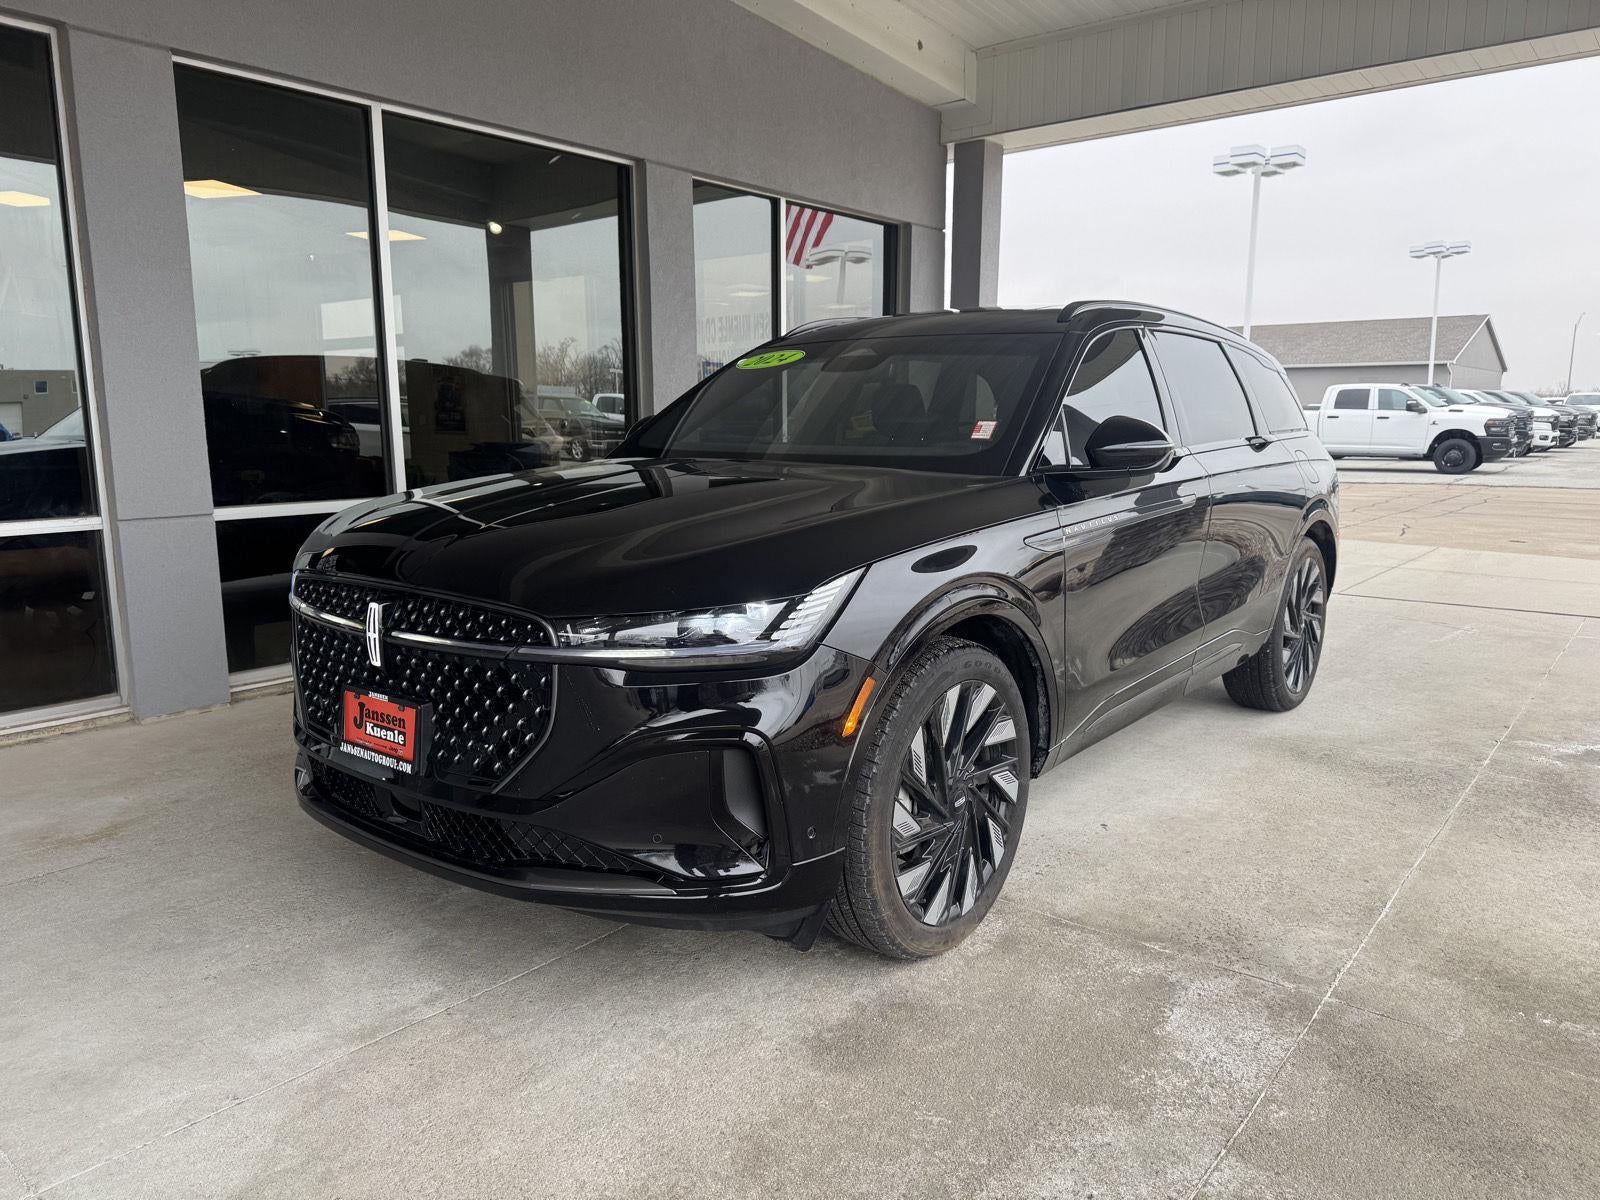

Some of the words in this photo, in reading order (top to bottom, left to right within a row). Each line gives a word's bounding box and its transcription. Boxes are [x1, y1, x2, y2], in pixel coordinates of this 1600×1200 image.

[1065, 515, 1119, 535] NAUTILUS
[354, 702, 405, 729] Janssen
[365, 722, 405, 744] Kuenle
